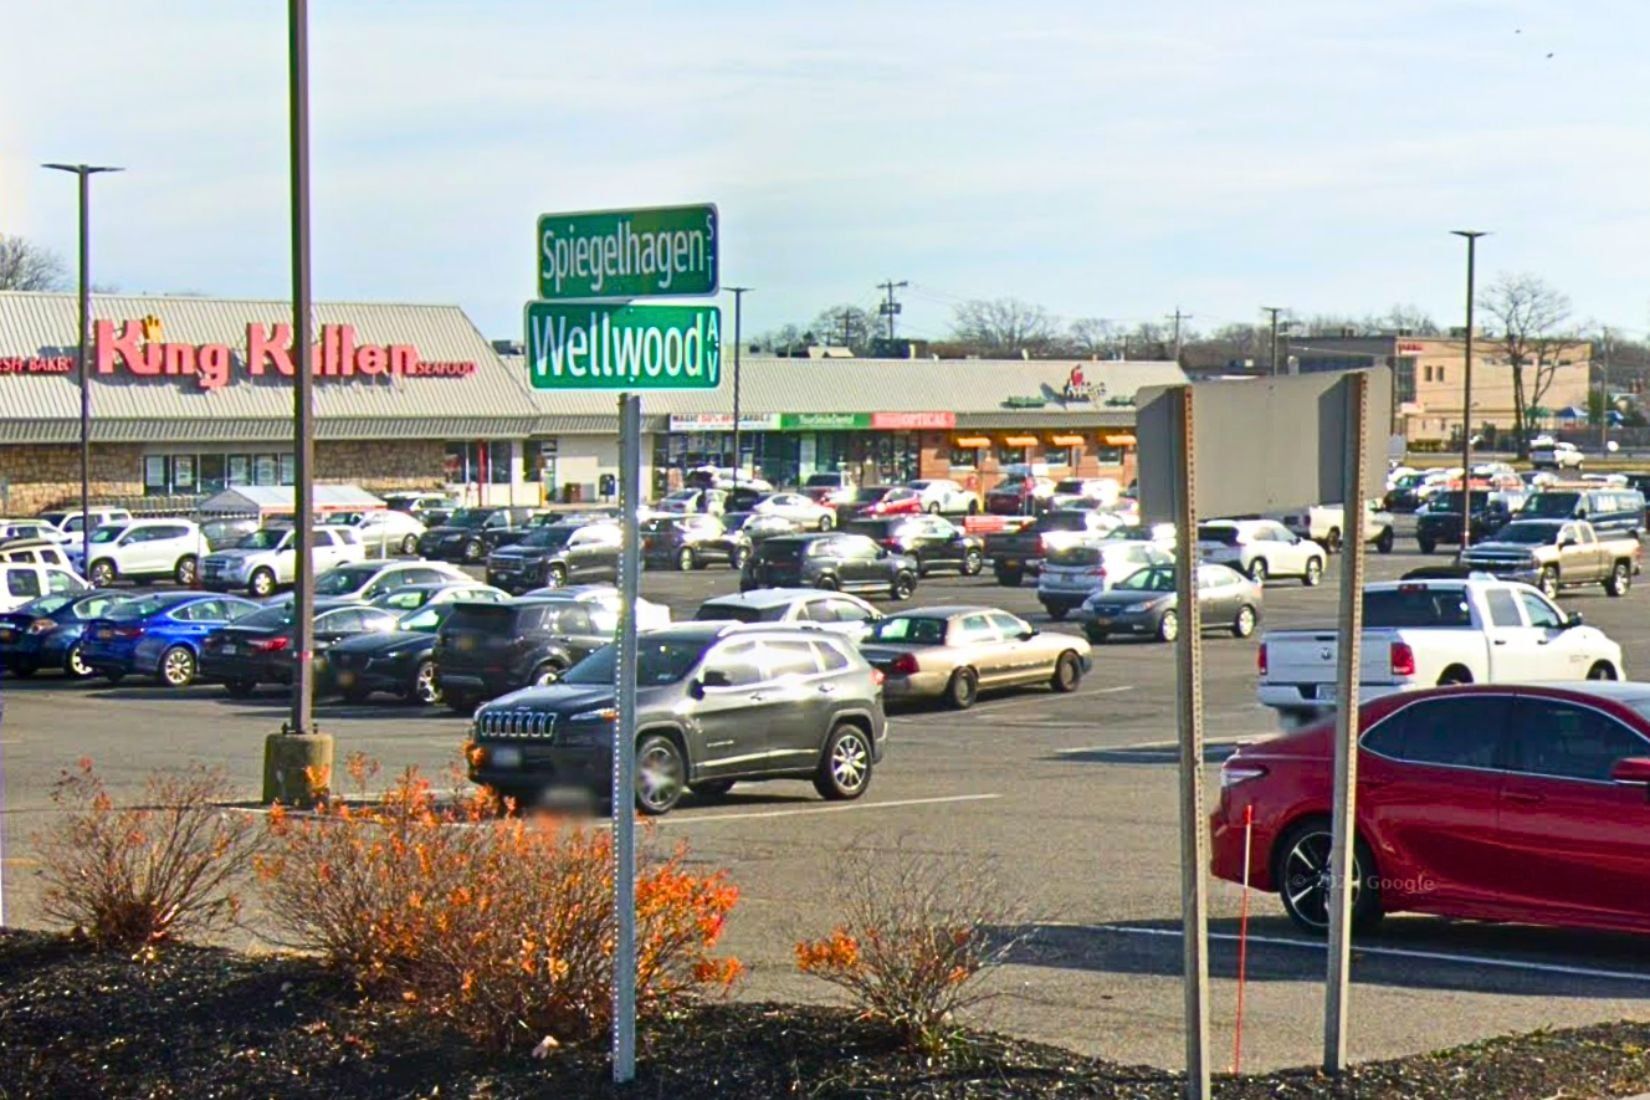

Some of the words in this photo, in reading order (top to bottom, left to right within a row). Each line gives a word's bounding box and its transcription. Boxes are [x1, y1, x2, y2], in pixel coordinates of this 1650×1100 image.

[542, 220, 704, 293] Spiegelhagen
[0, 356, 23, 373] SH
[94, 316, 229, 388] King
[416, 361, 476, 376] SEAFOOD
[532, 311, 703, 377] Wellwood
[706, 310, 718, 382] AV
